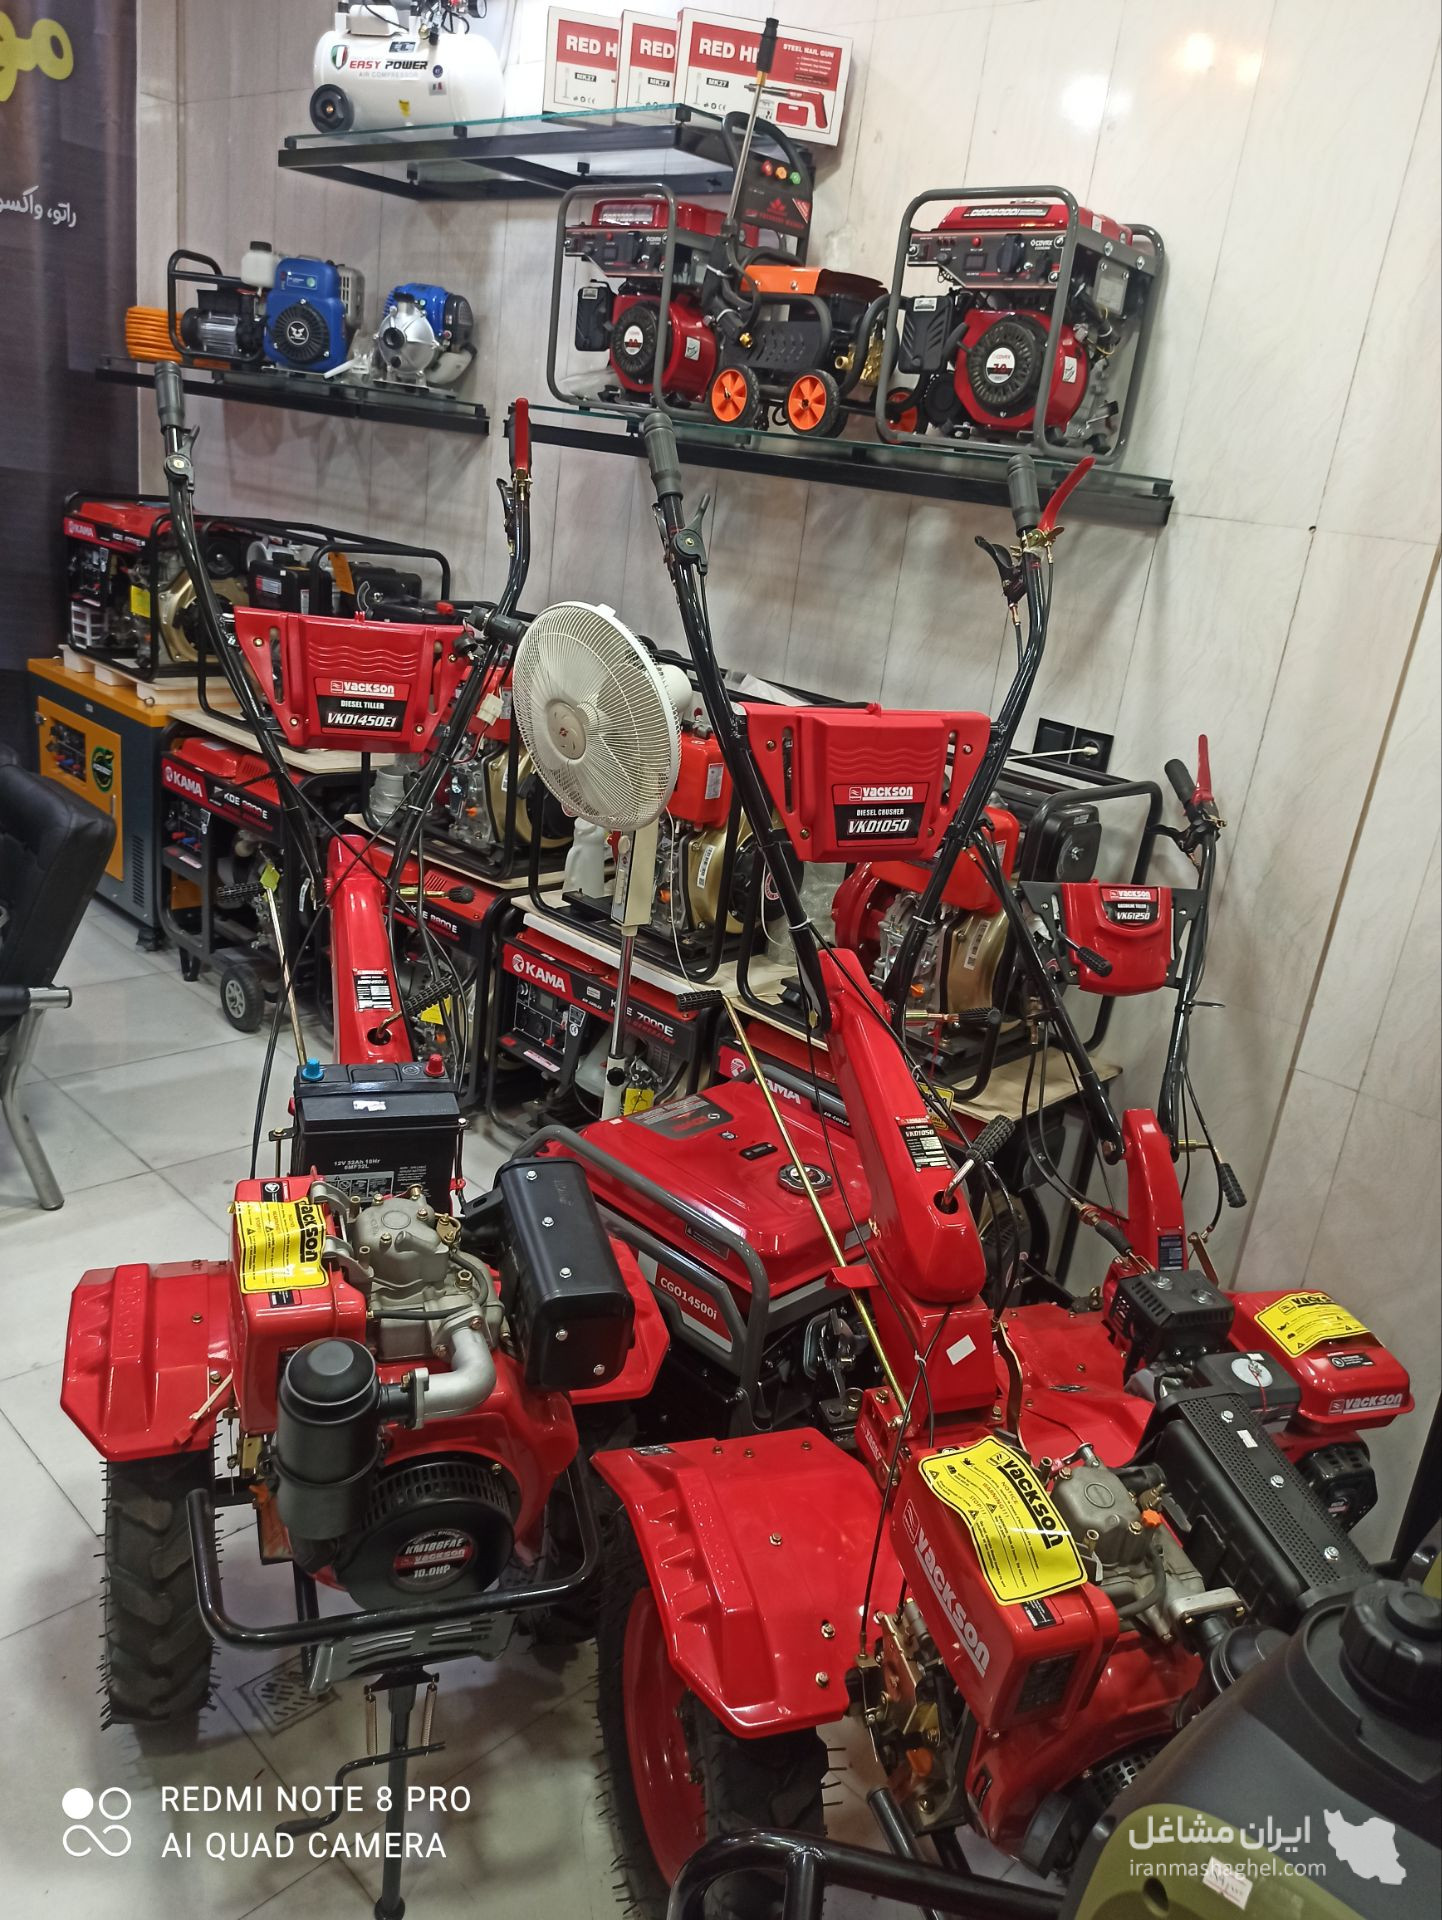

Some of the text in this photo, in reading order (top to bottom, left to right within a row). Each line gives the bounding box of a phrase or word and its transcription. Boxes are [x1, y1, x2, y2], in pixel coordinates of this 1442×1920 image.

[565, 34, 618, 59] RED H
[639, 37, 675, 59] RED
[698, 37, 759, 64] RED HI
[783, 43, 803, 53] STEEL
[349, 60, 428, 71] EASY POWER
[707, 78, 728, 88] MK27
[340, 699, 385, 710] DIESEL TILLER
[326, 711, 398, 728] VKD1450E1
[172, 770, 203, 798] KAMA
[856, 808, 878, 817] DIESEL
[848, 819, 911, 834] VKD1050
[410, 904, 429, 920] KE
[525, 960, 567, 993] KAMA
[610, 998, 675, 1037] KE 7000E
[660, 1276, 718, 1321] CGO14500i
[1001, 1481, 1019, 1505] NOTICE
